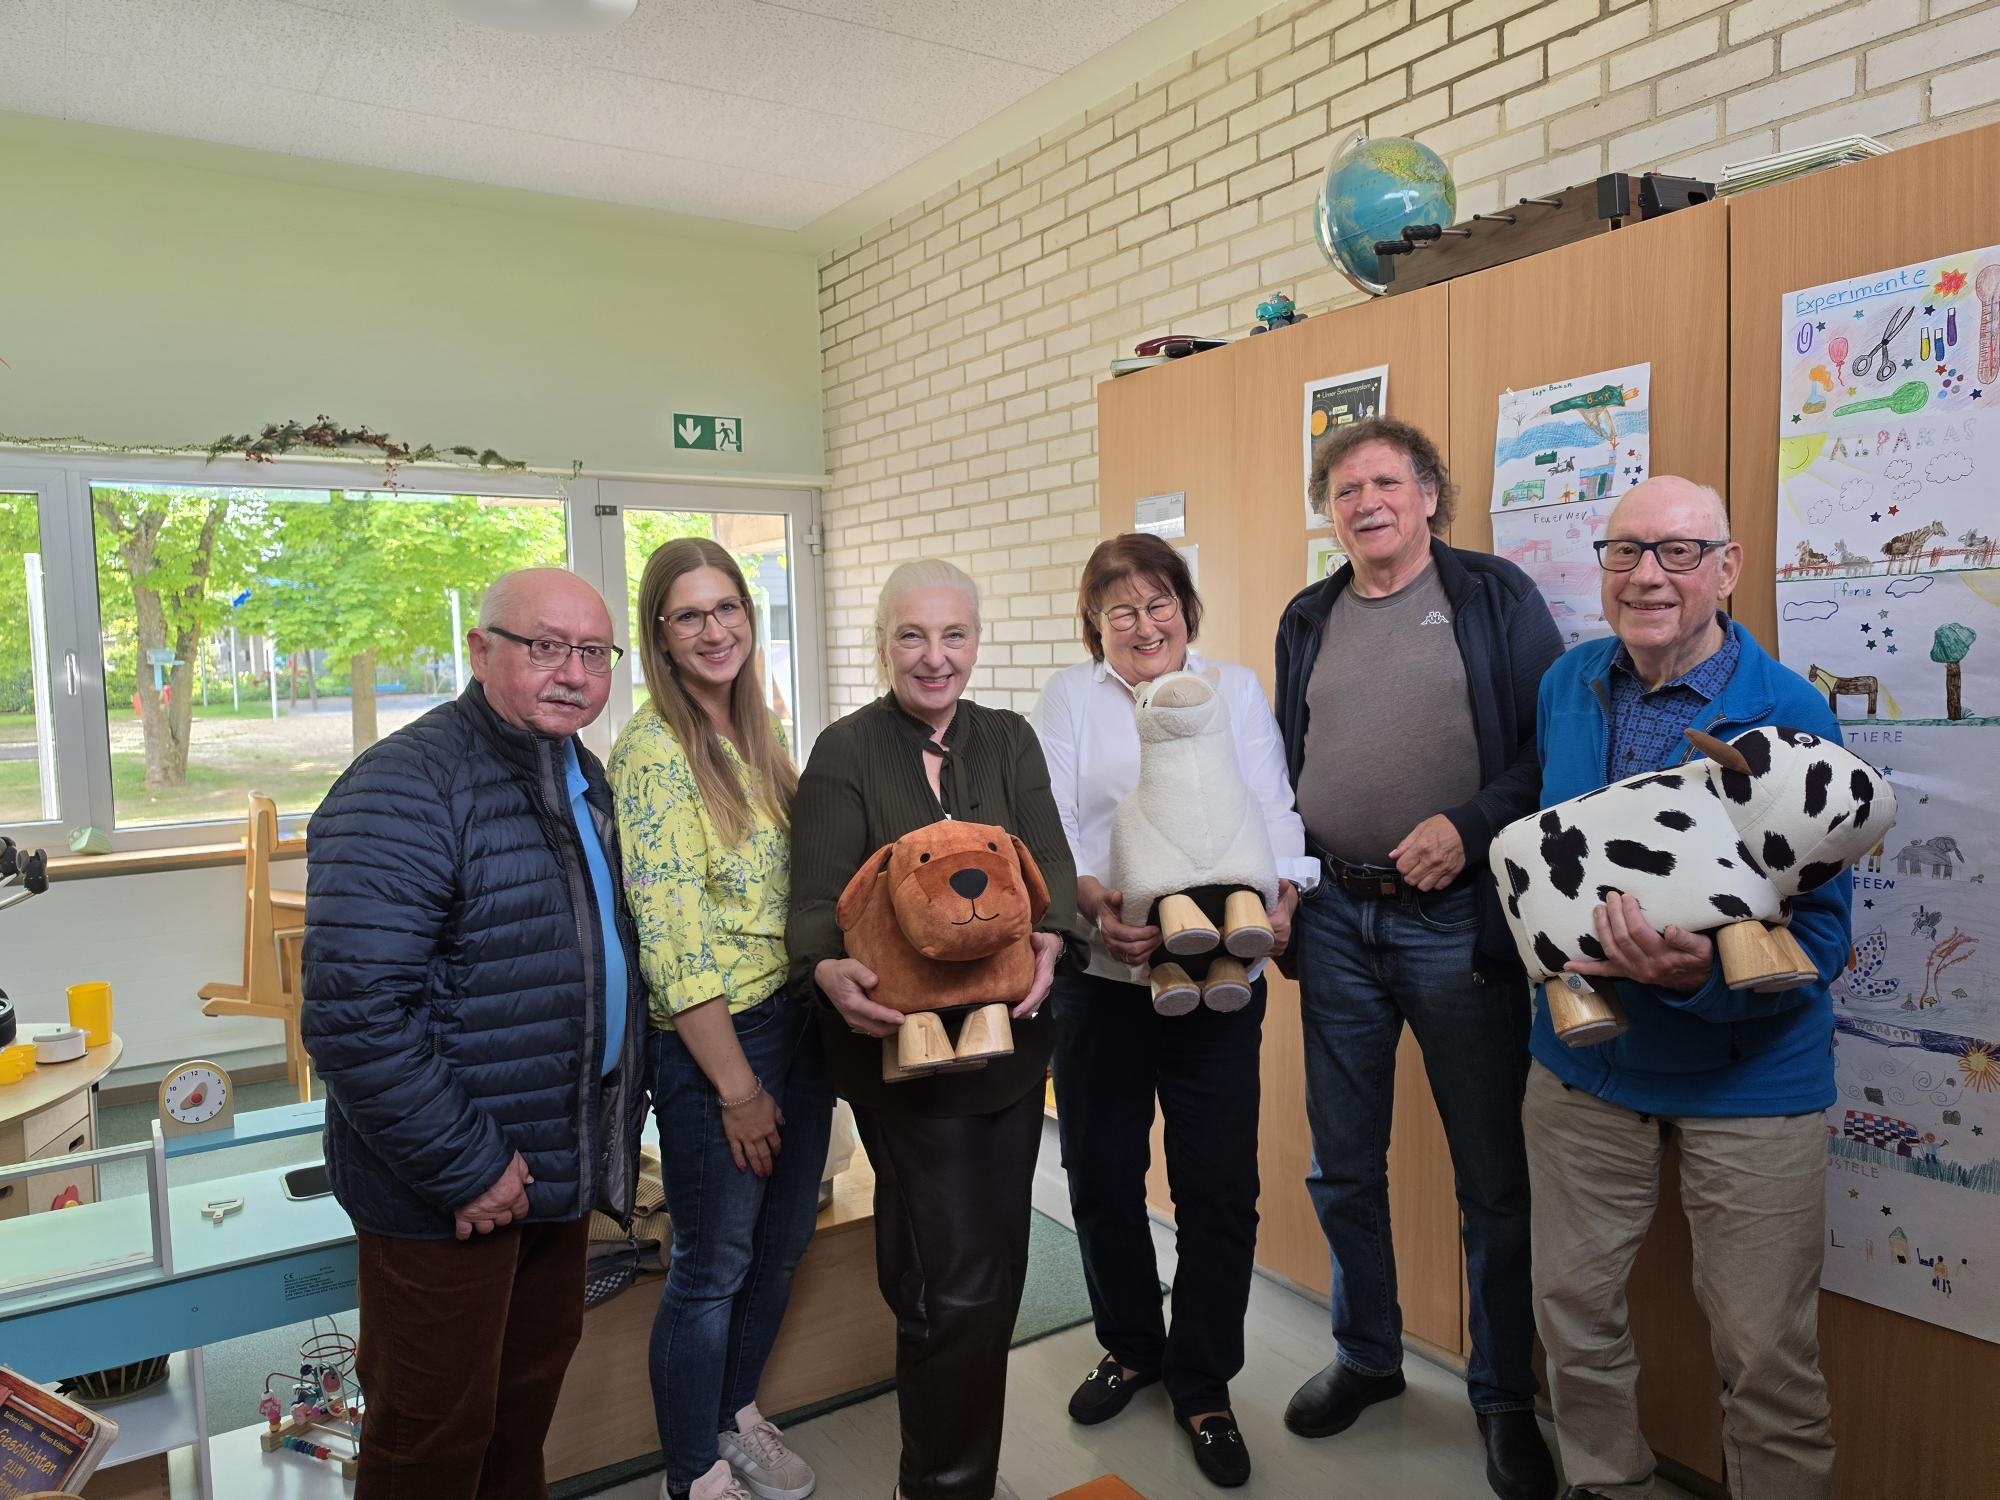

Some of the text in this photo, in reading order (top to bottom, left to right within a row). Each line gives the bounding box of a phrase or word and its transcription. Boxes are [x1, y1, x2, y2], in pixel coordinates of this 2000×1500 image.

[1796, 269, 1926, 314] Experimente
[1848, 731, 1904, 743] TIERE
[1853, 876, 1895, 889] FEEN
[0, 1428, 58, 1477] Geschichten
[2, 1459, 27, 1479] zum
